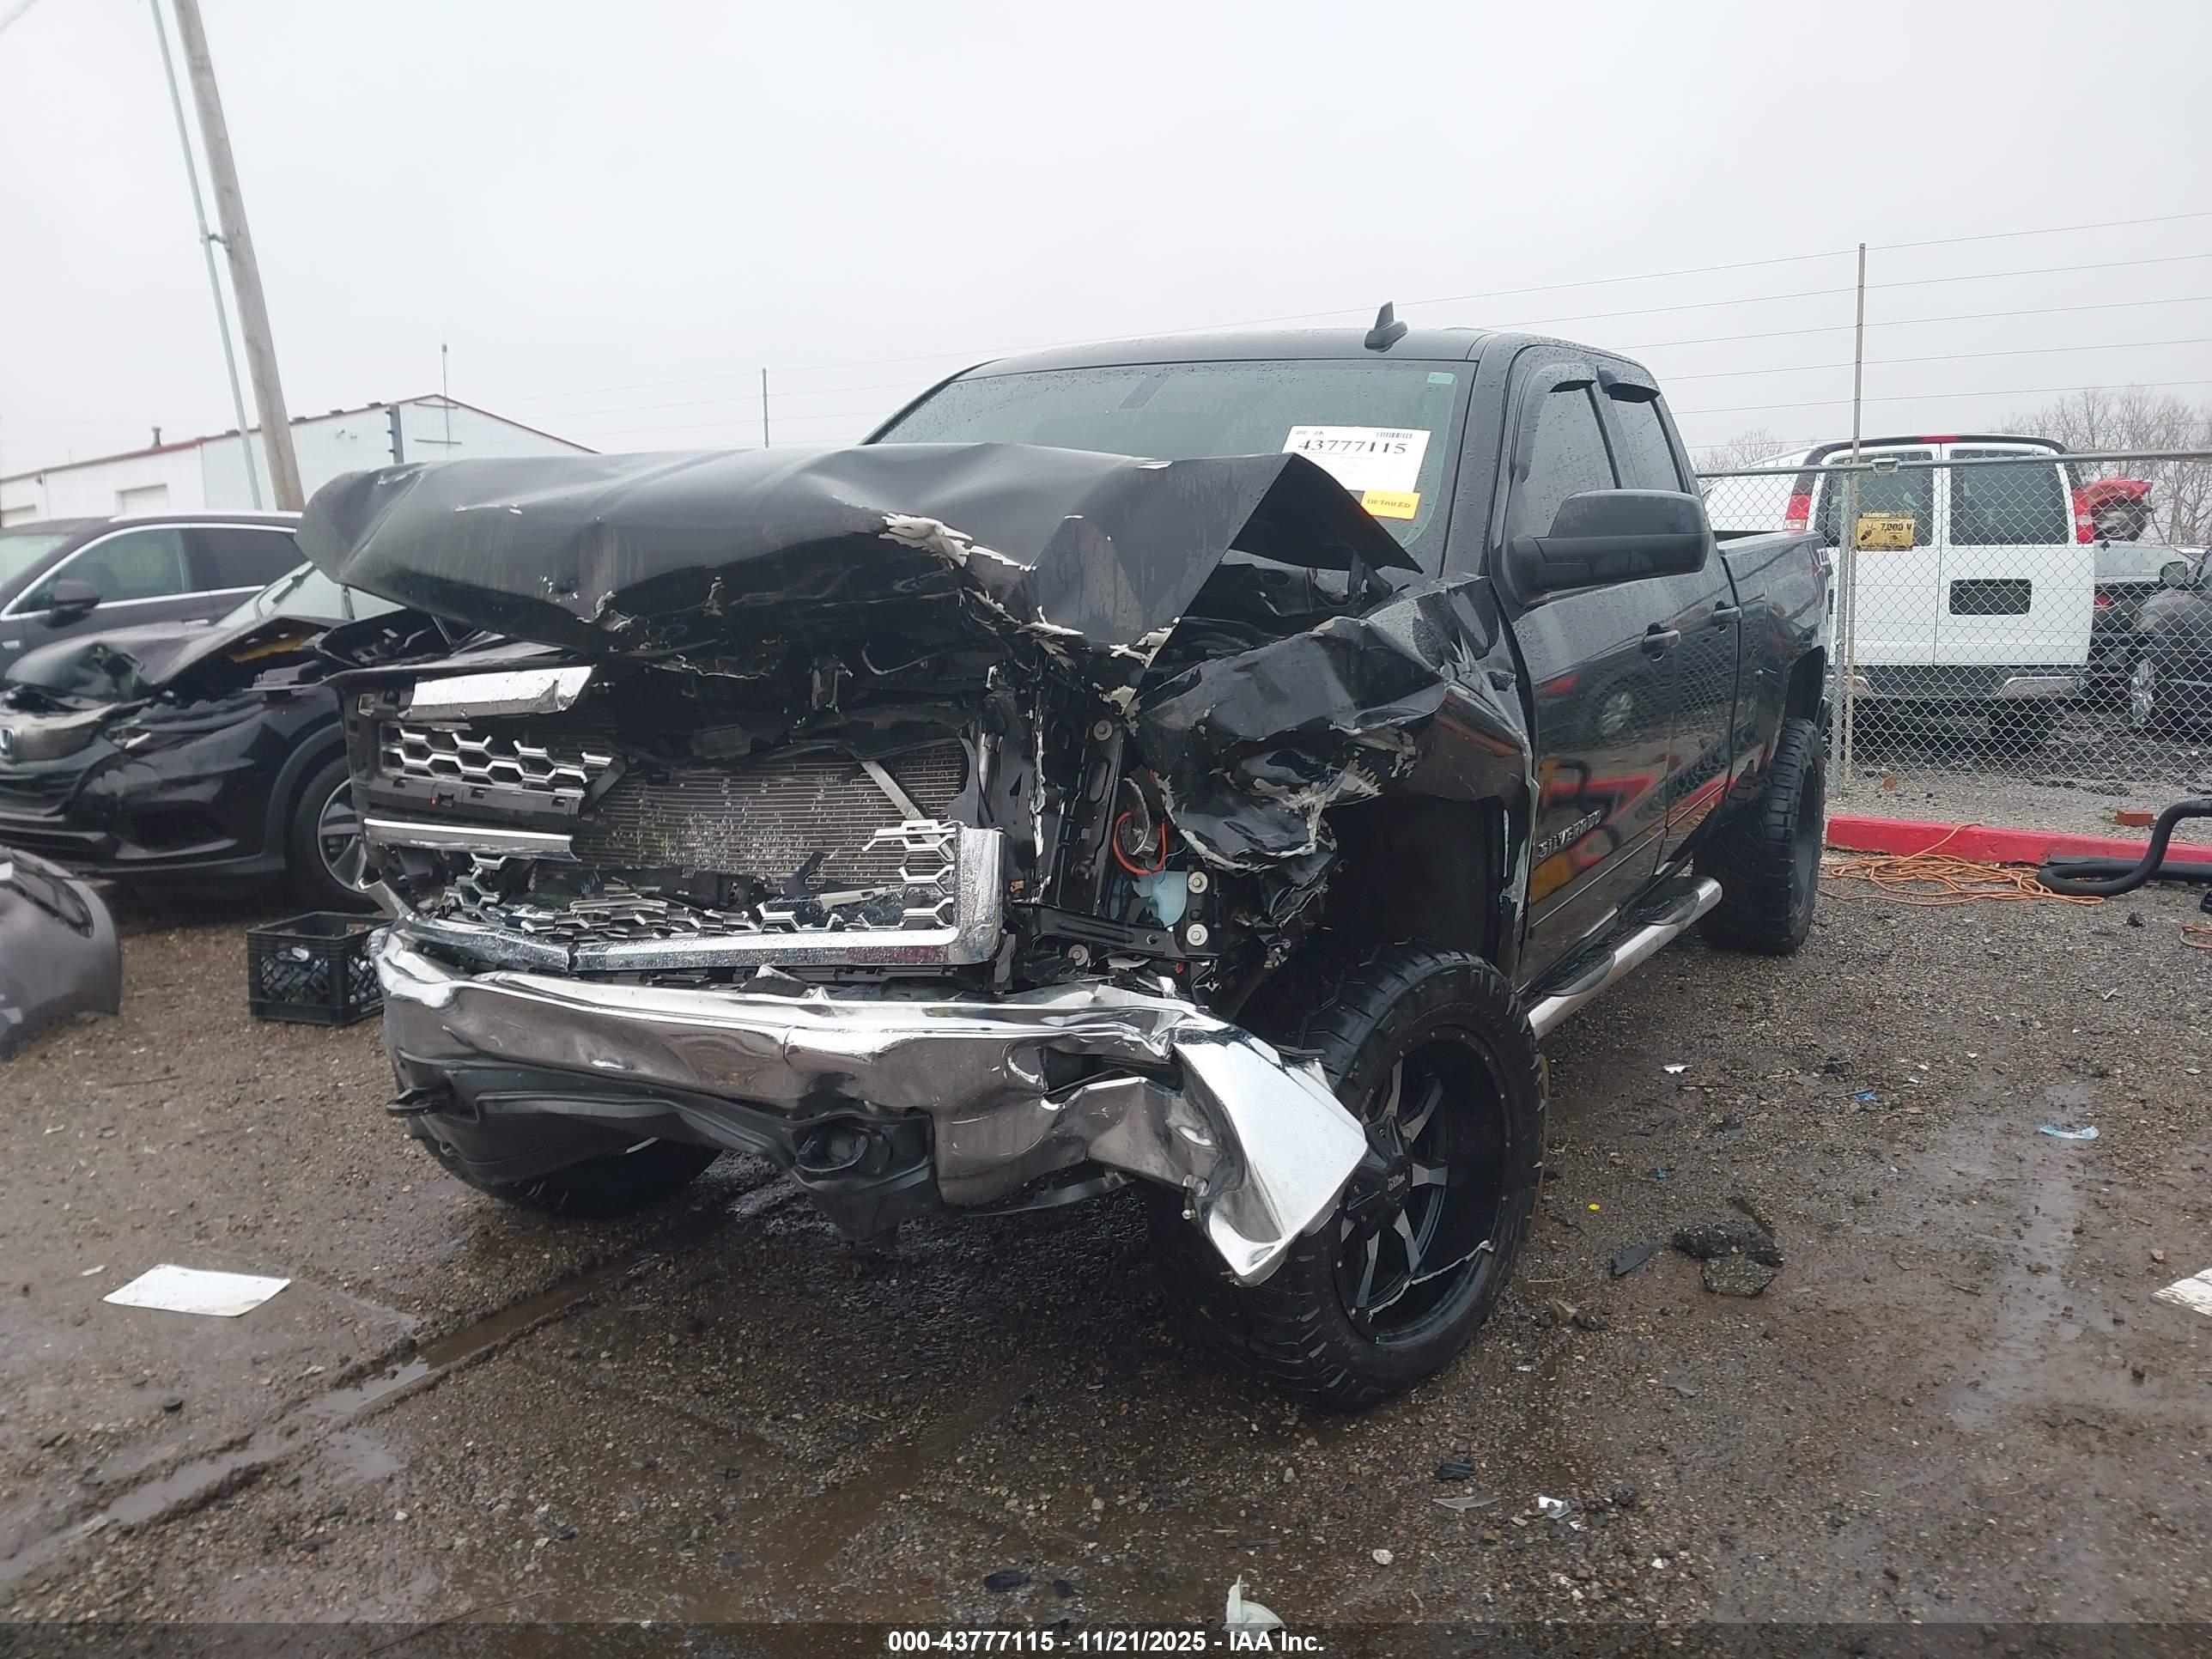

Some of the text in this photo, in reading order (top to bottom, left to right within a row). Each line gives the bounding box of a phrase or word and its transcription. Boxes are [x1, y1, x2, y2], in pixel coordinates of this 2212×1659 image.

[1297, 439, 1408, 454] 43777115
[1367, 499, 1411, 508] DETAILED
[1881, 522, 1904, 532] 7,000
